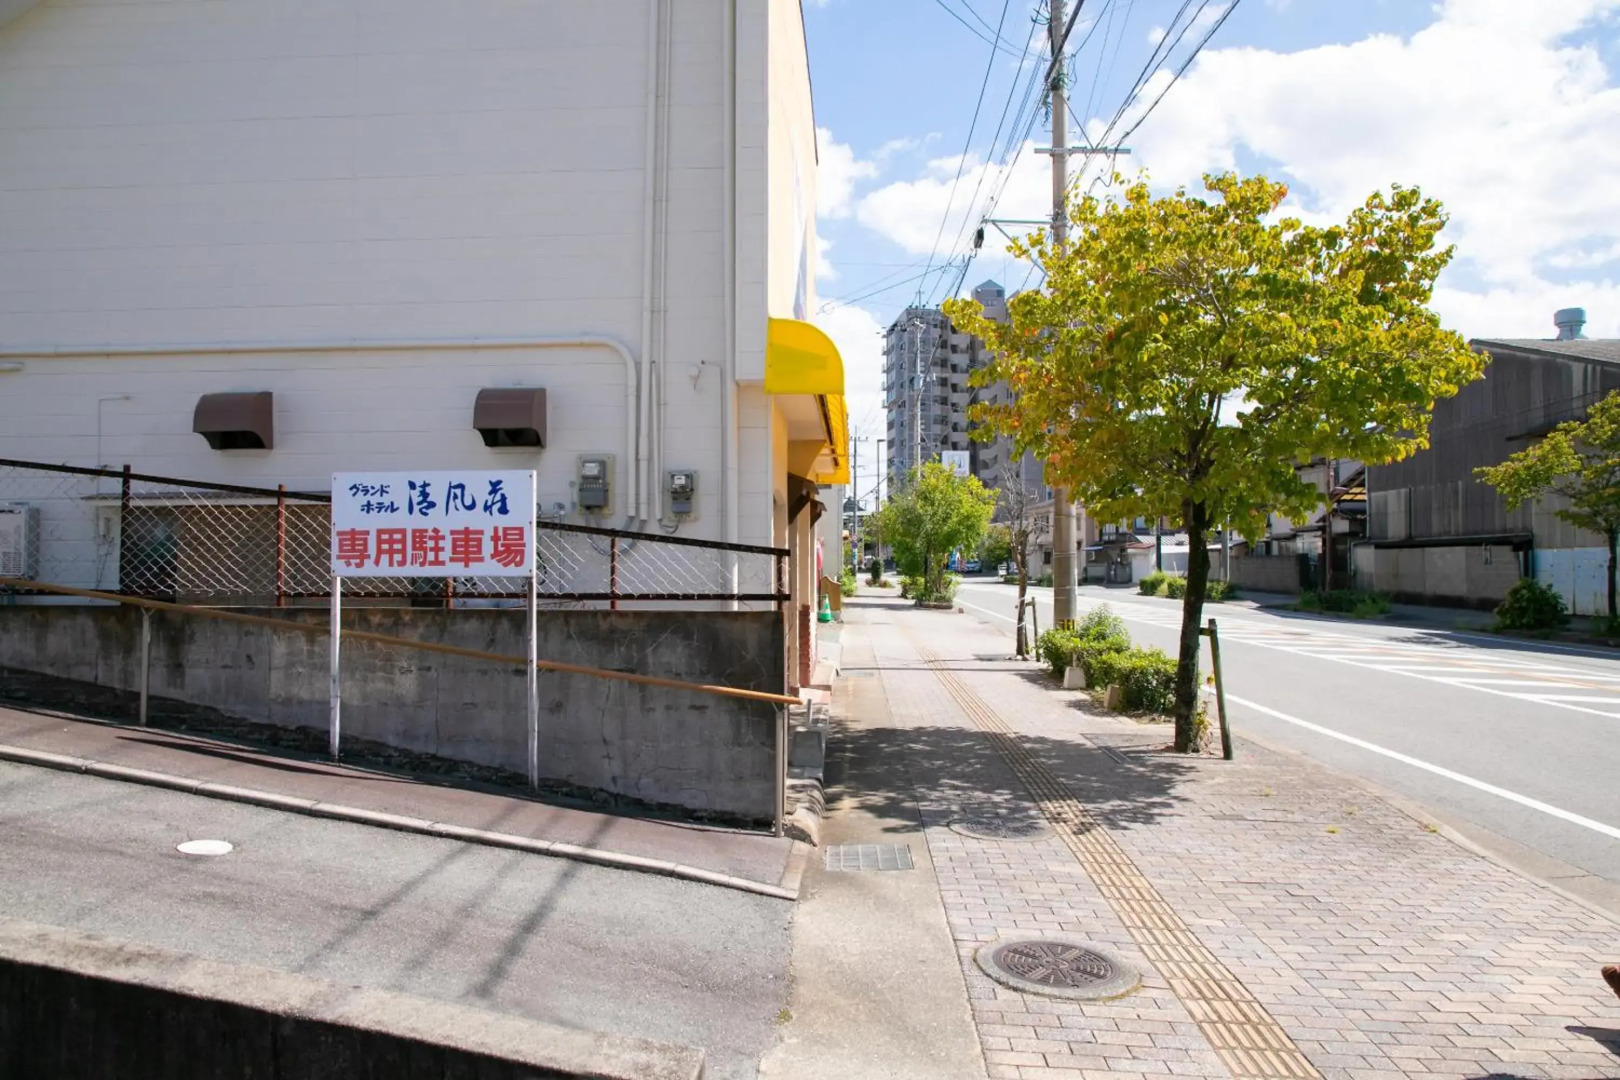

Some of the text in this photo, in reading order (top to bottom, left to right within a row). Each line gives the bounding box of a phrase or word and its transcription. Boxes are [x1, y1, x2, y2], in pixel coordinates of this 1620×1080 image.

[349, 483, 390, 498] グランド
[360, 500, 400, 514] ホテル
[336, 526, 526, 568] 専用駐車場
